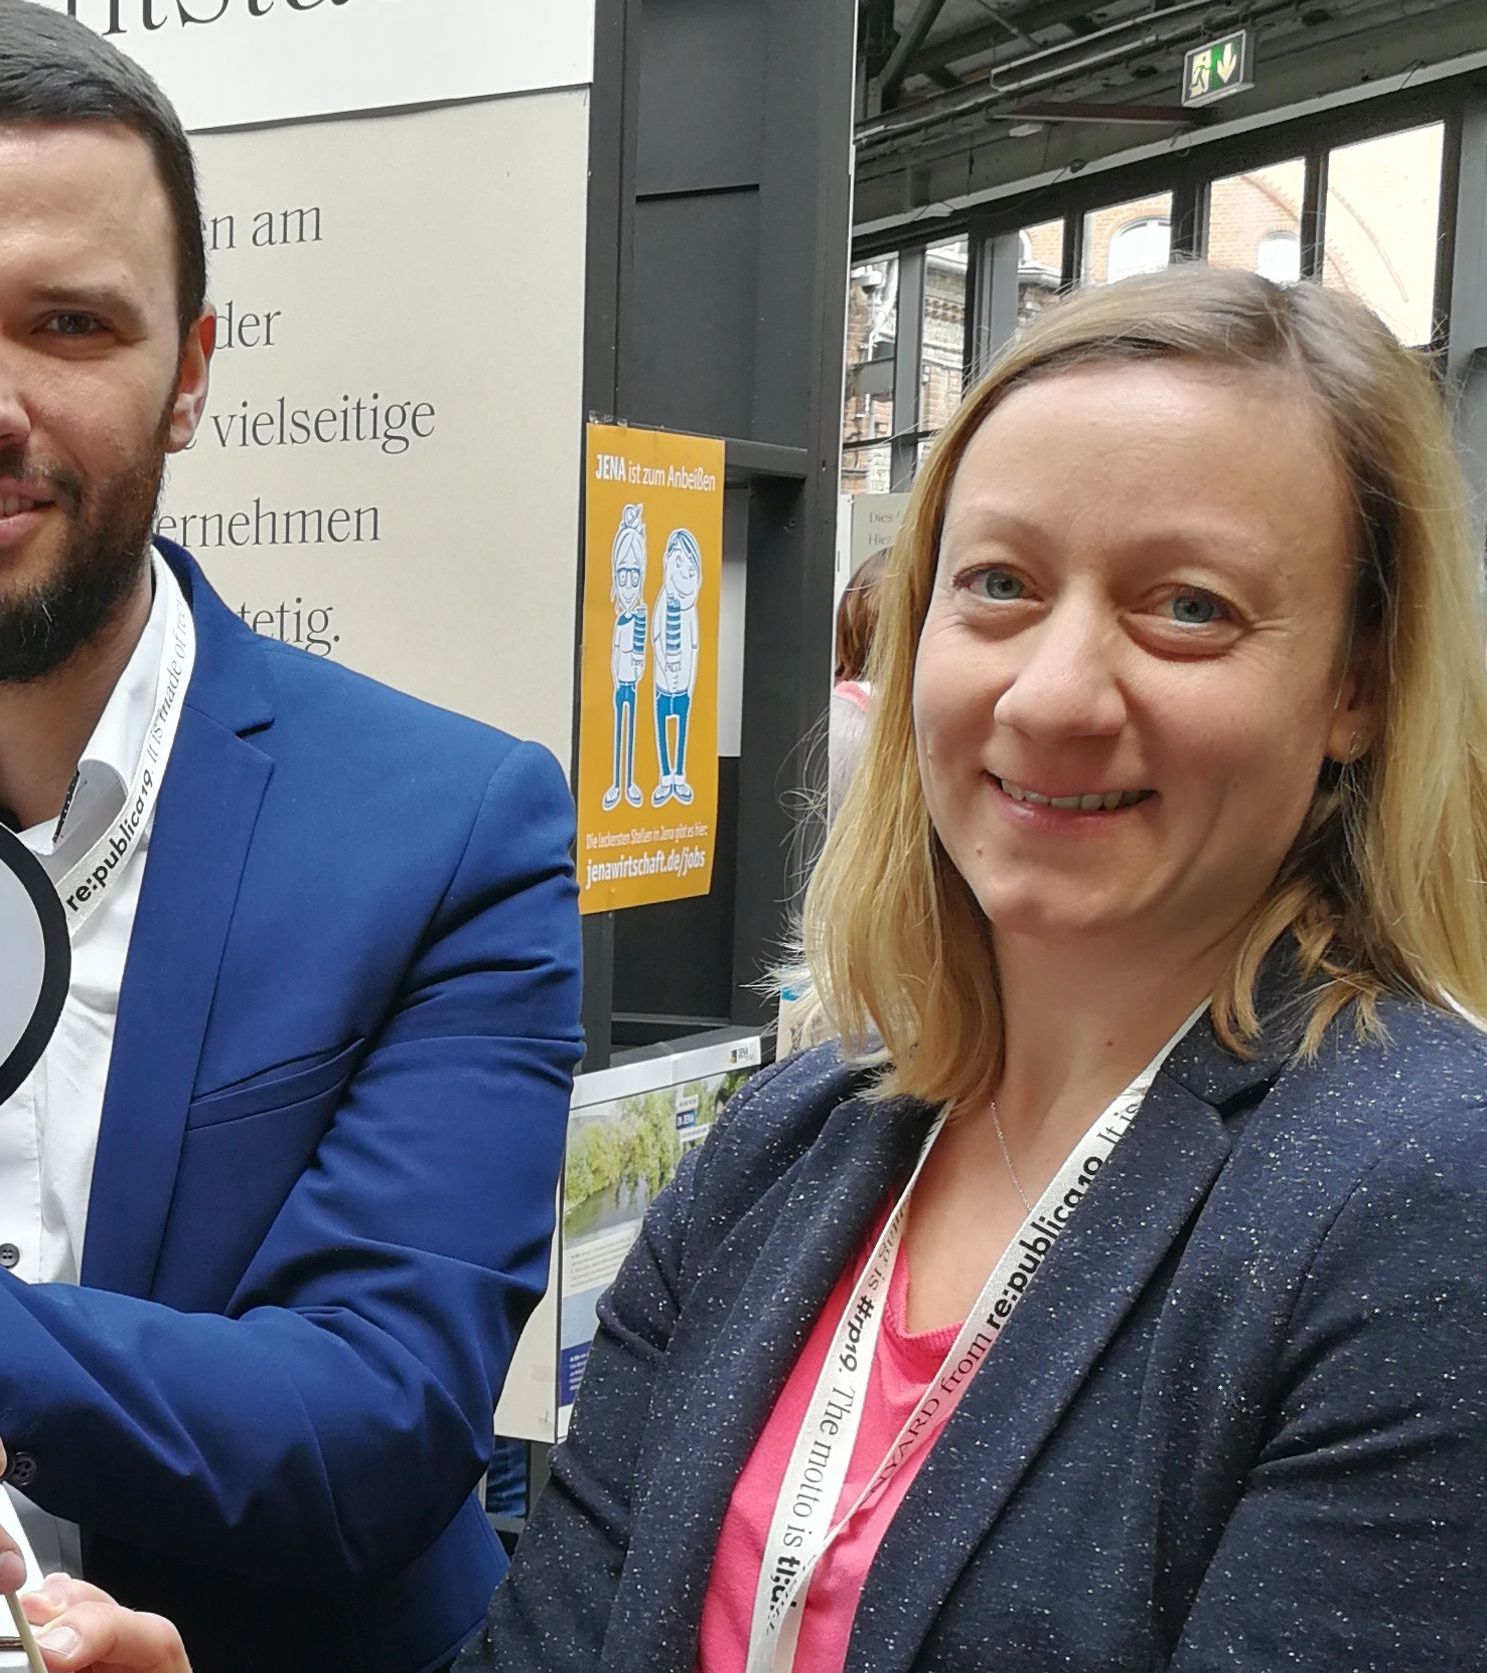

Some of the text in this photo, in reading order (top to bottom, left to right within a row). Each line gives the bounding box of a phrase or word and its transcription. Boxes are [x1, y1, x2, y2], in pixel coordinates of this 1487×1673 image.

[251, 206, 323, 247] am
[215, 300, 282, 350] der
[210, 393, 435, 454] vielseitige
[595, 454, 716, 492] JENA ist zum Anbeißen
[155, 497, 381, 548] ernehmen
[237, 597, 341, 657] tetig.
[585, 845, 706, 890] jenawirtschaft.de/jobs
[868, 1269, 885, 1292] is
[839, 1296, 875, 1372] #rp19.
[940, 1333, 992, 1396] from
[819, 1386, 855, 1436] The
[792, 1440, 832, 1518] motto
[782, 1525, 813, 1548] is
